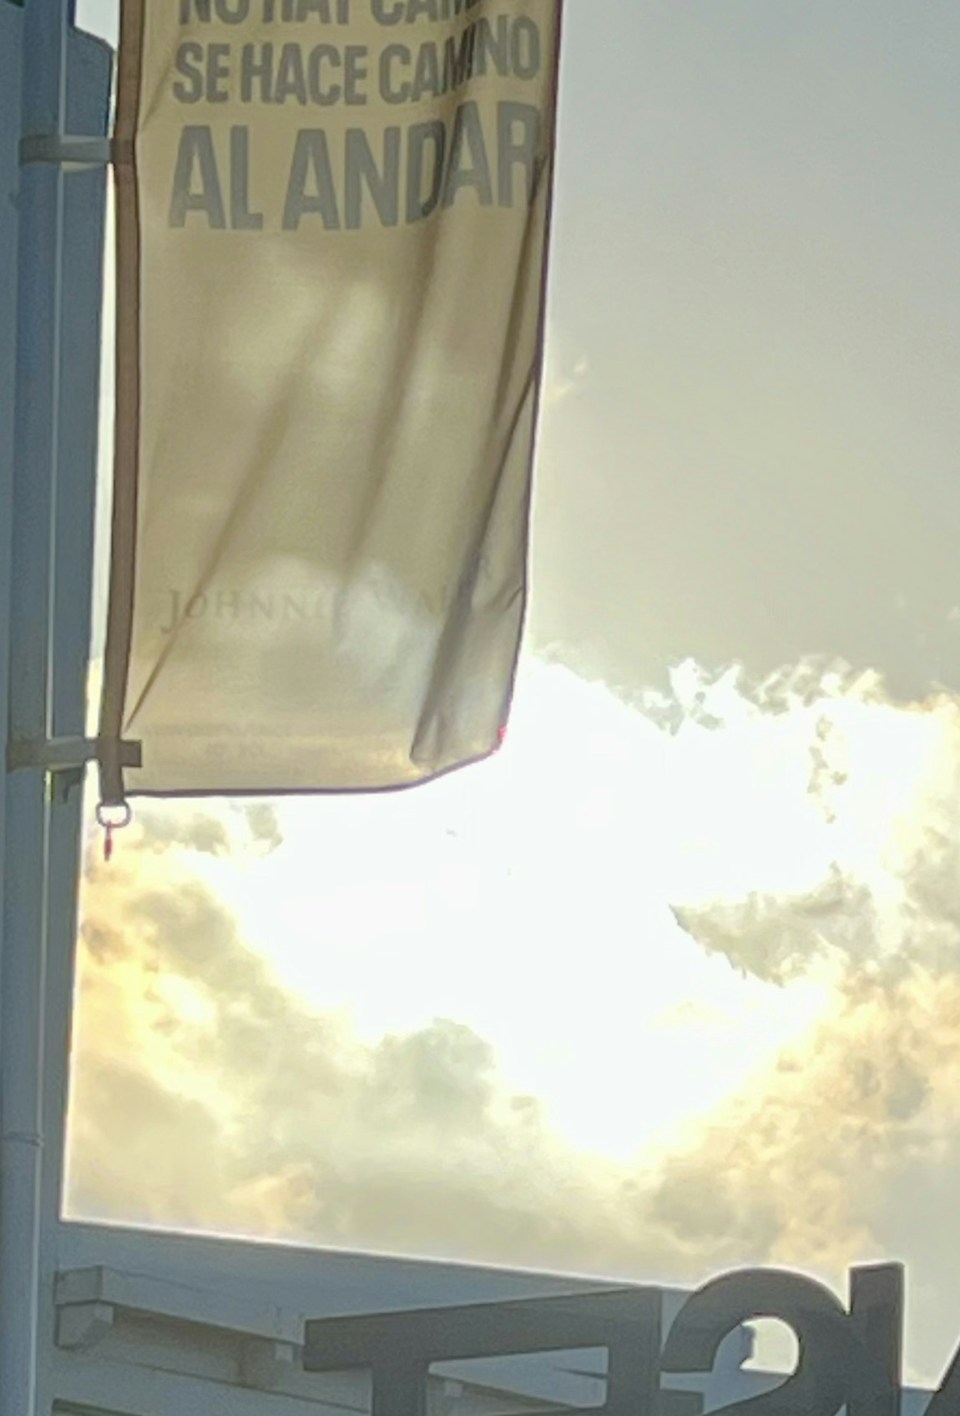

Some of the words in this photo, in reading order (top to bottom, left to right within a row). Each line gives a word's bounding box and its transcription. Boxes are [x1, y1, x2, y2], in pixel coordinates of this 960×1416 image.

[173, 42, 231, 104] SE
[241, 42, 368, 106] HACE
[168, 125, 263, 231] AL
[281, 101, 541, 232] ANDAR
